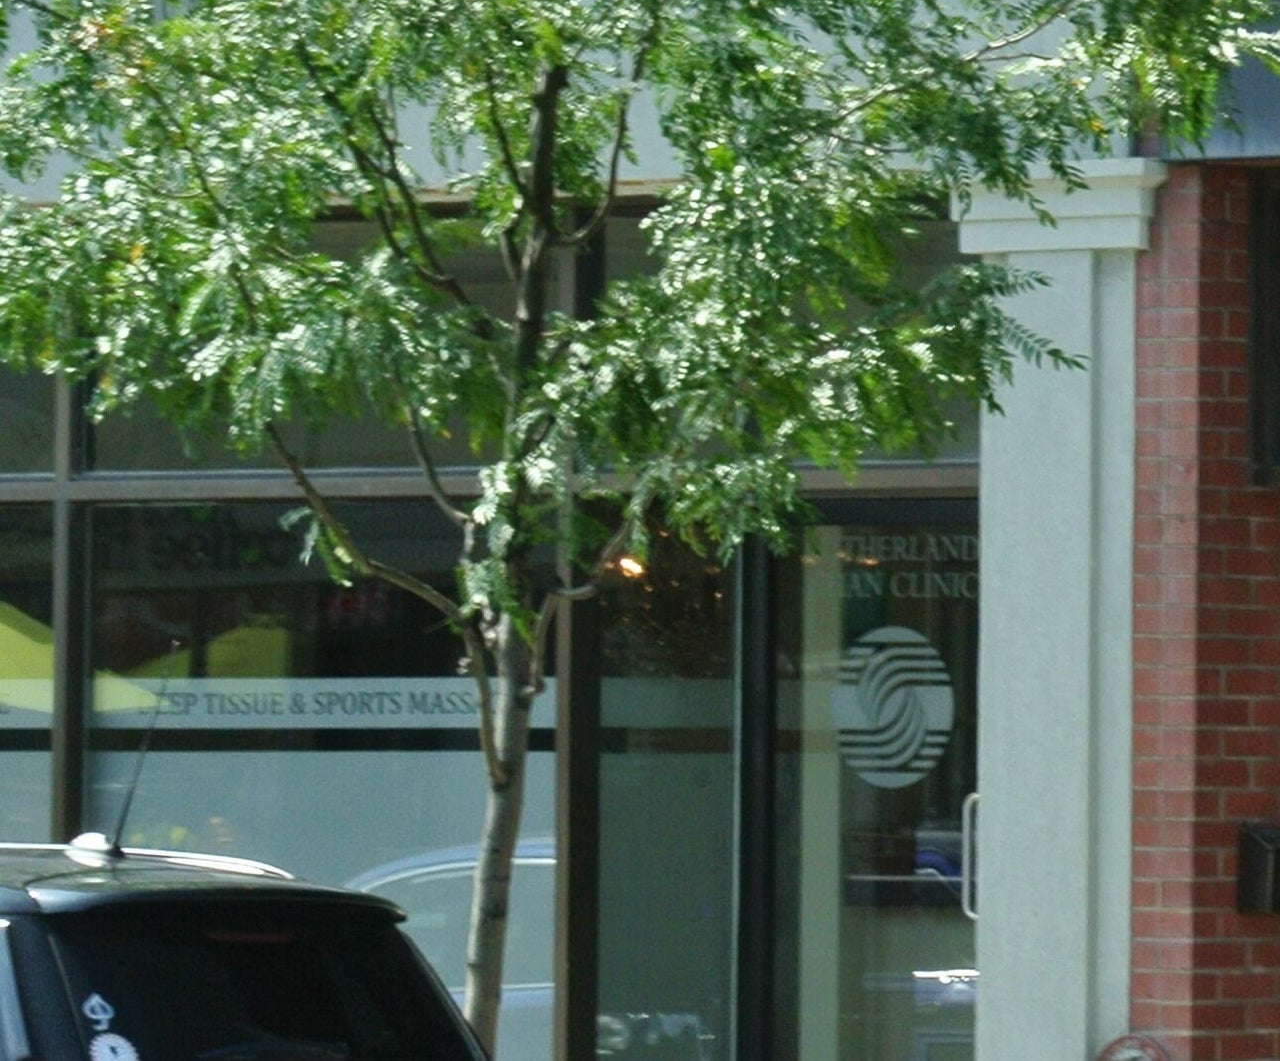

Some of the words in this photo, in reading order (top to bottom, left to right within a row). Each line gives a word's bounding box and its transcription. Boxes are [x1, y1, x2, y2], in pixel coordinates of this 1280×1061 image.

[203, 692, 283, 716] TISSUE
[288, 693, 307, 716] &
[312, 691, 403, 716] SPORTS
[407, 691, 482, 715] MASS
